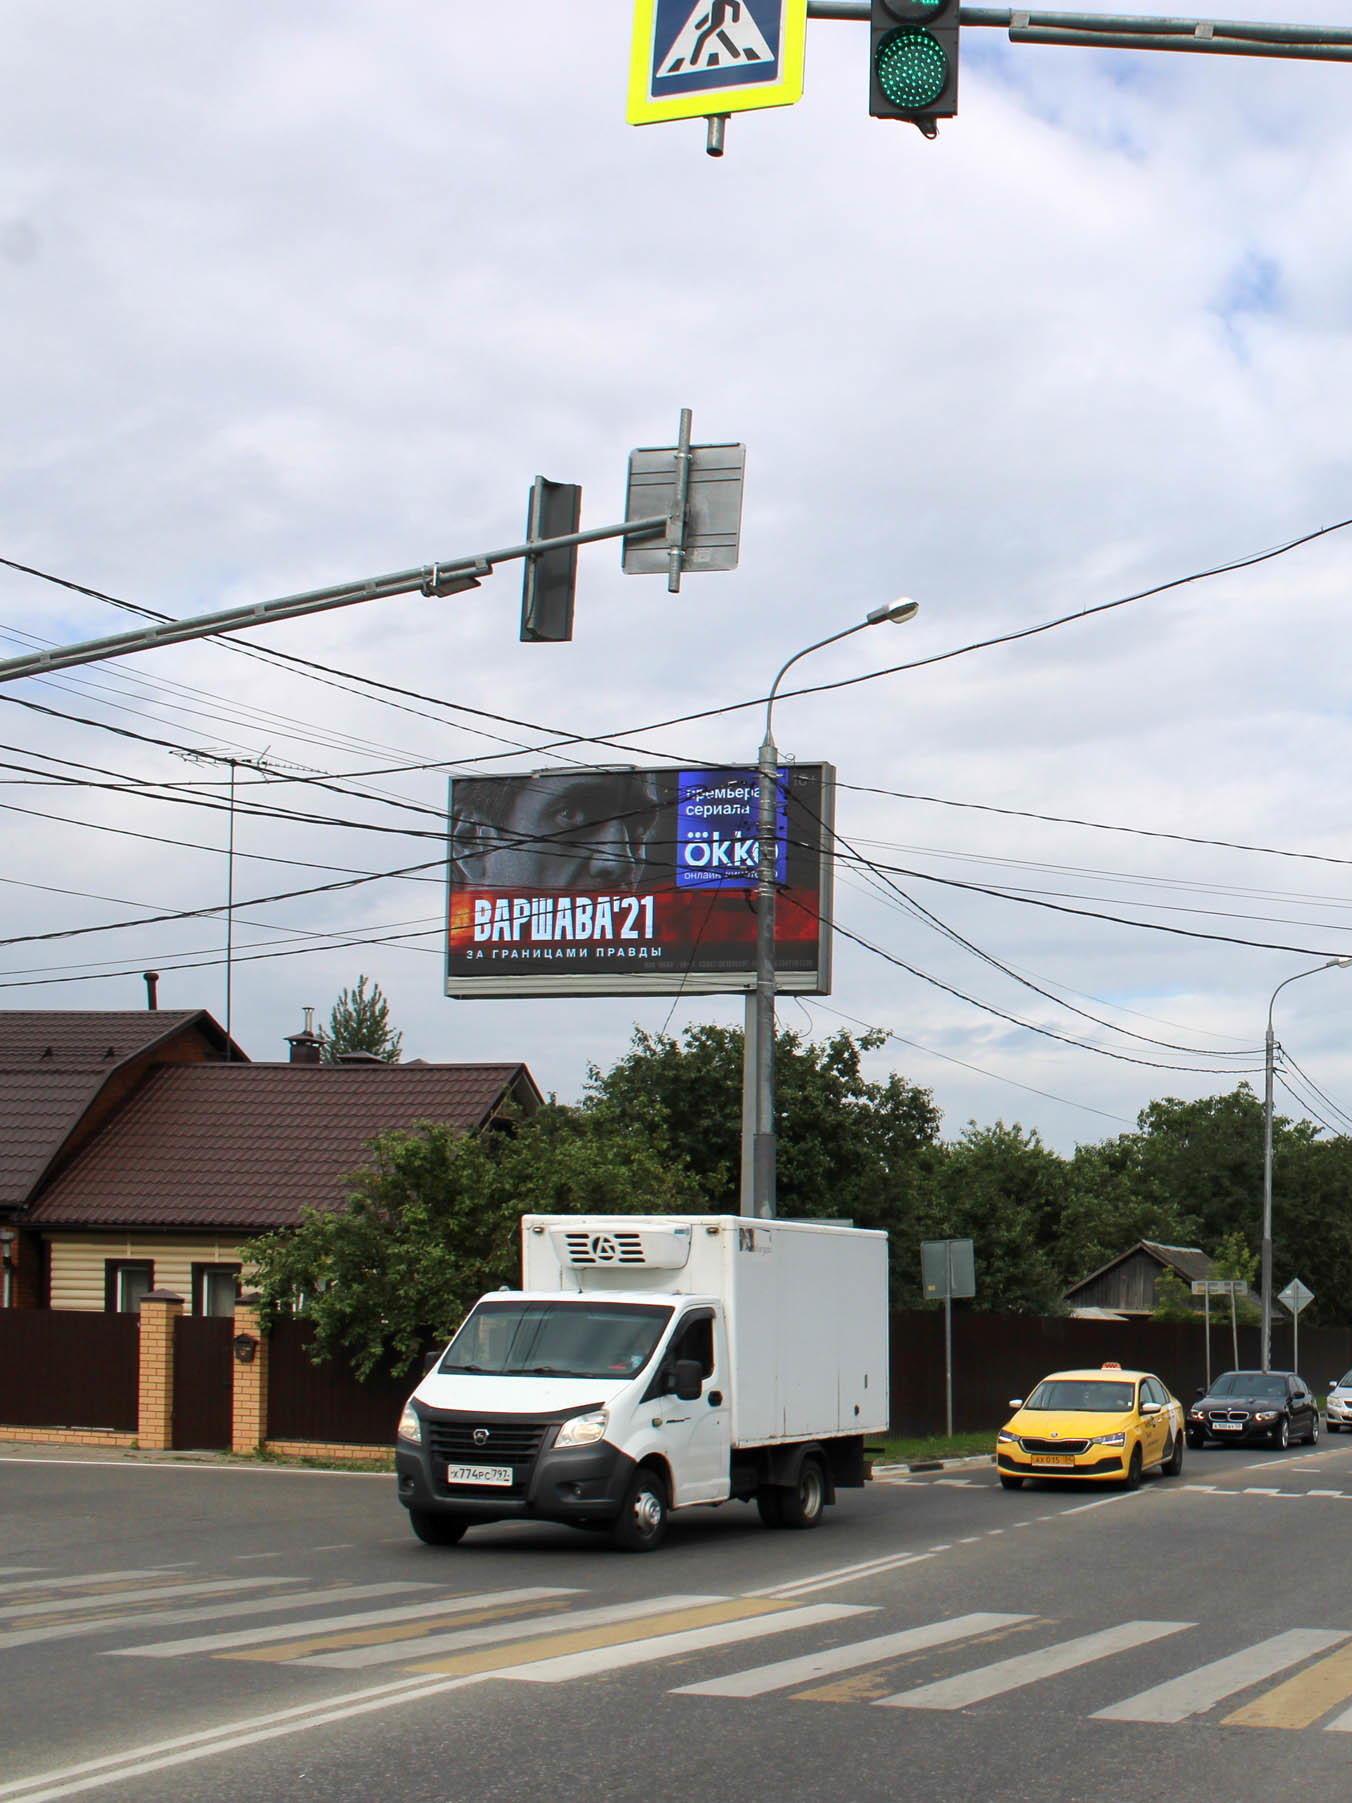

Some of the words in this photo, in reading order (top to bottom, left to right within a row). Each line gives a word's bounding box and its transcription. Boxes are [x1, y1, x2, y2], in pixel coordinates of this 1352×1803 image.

[685, 805, 750, 818] сериала
[473, 895, 655, 942] ВАРШАВА'21
[466, 950, 484, 960] ЗА
[492, 948, 588, 960] ГРАНИЦАМИ
[596, 946, 662, 959] ПРАВДЫ
